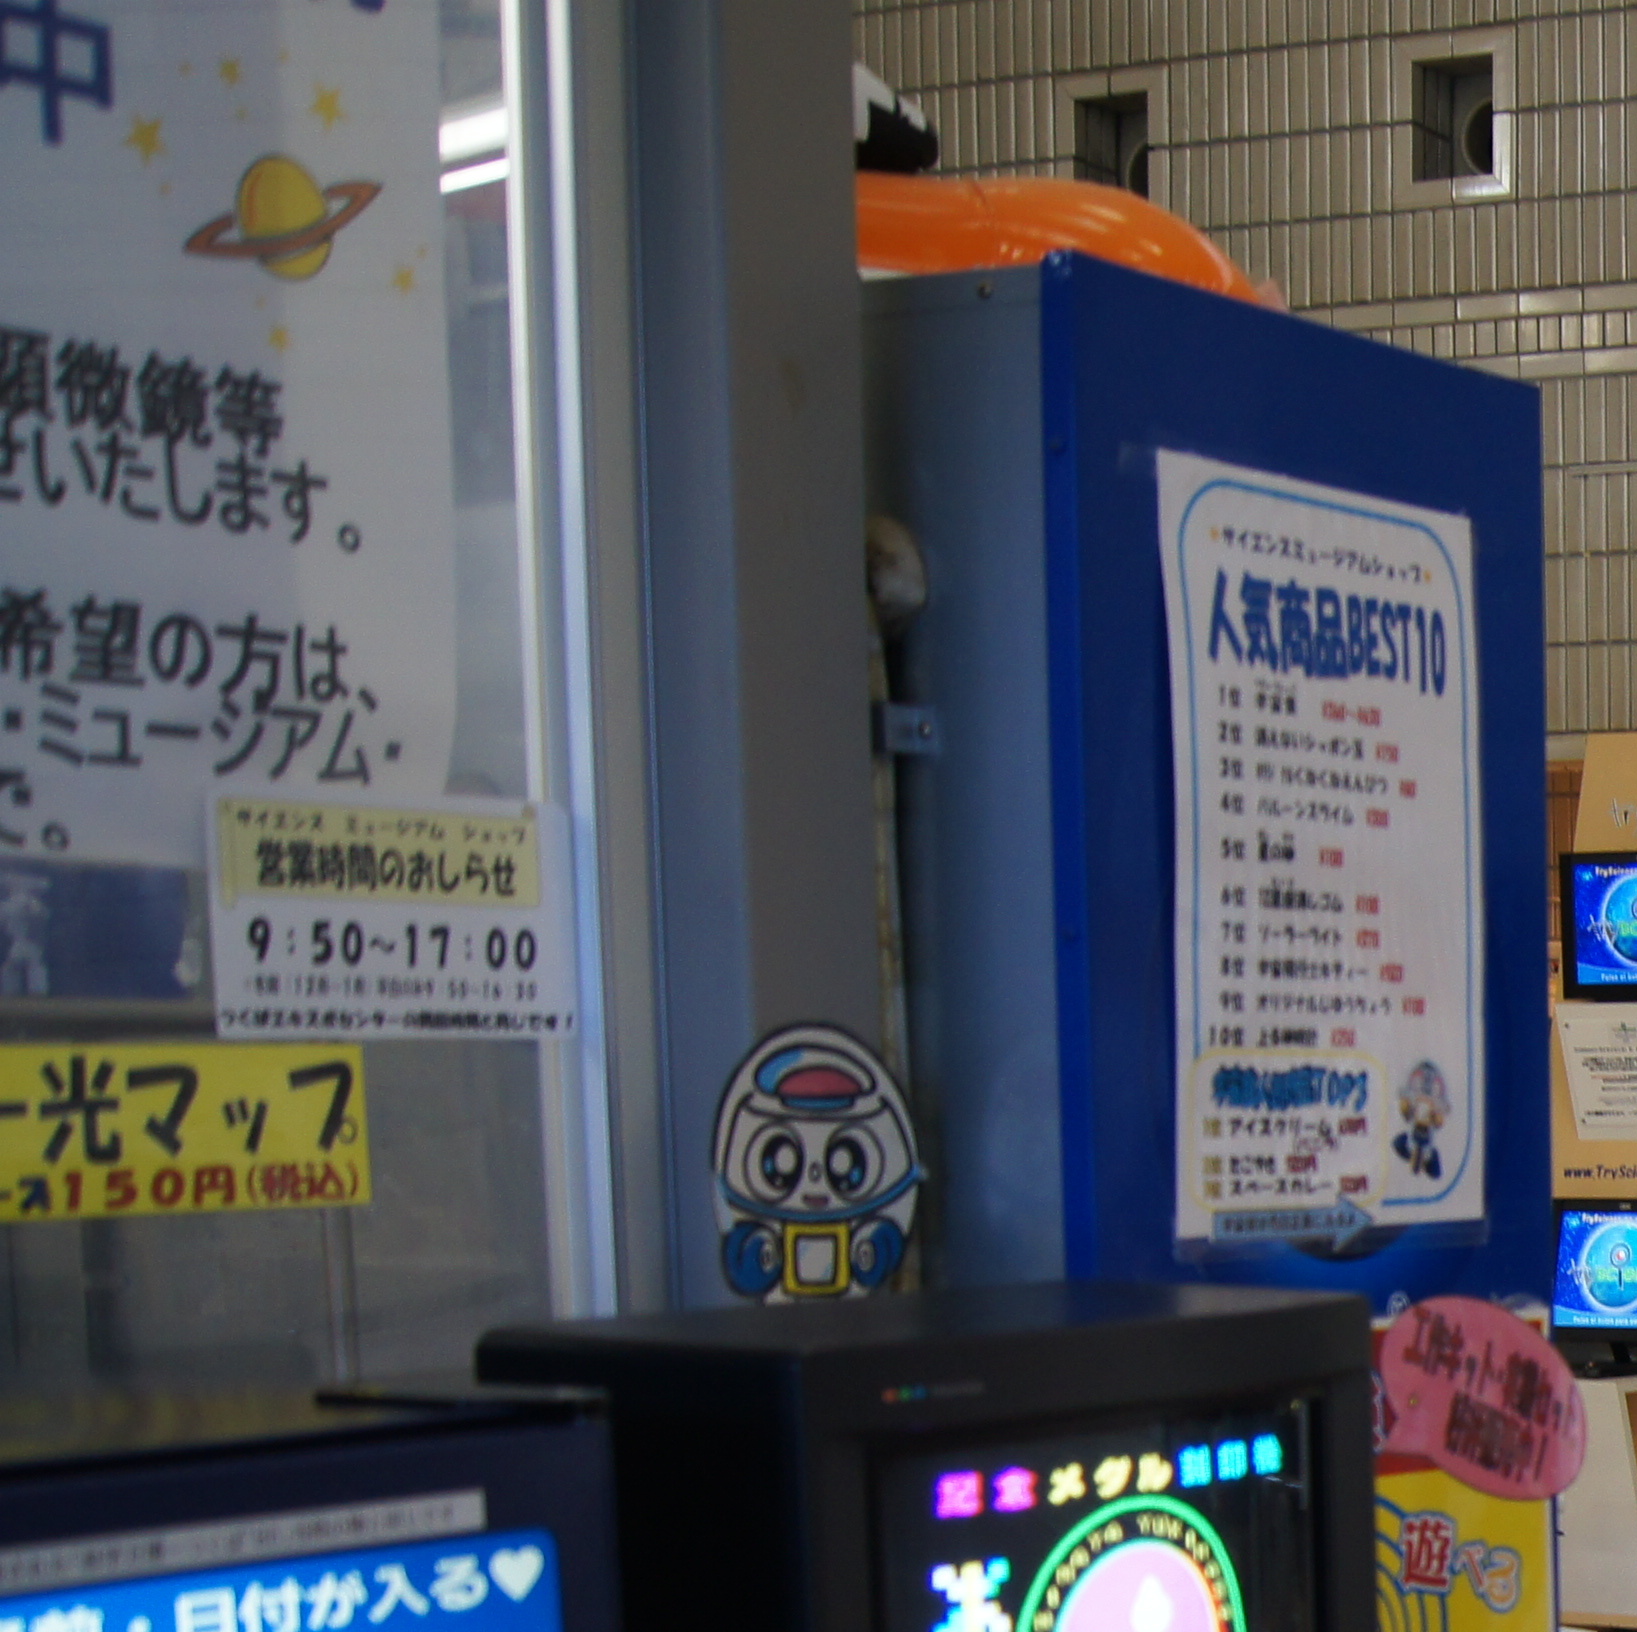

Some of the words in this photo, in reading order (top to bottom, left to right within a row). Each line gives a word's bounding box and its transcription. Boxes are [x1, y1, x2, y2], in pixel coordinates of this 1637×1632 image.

[1208, 568, 1447, 698] 人気商品BEST10
[257, 838, 517, 897] 営業時間のおしらせ
